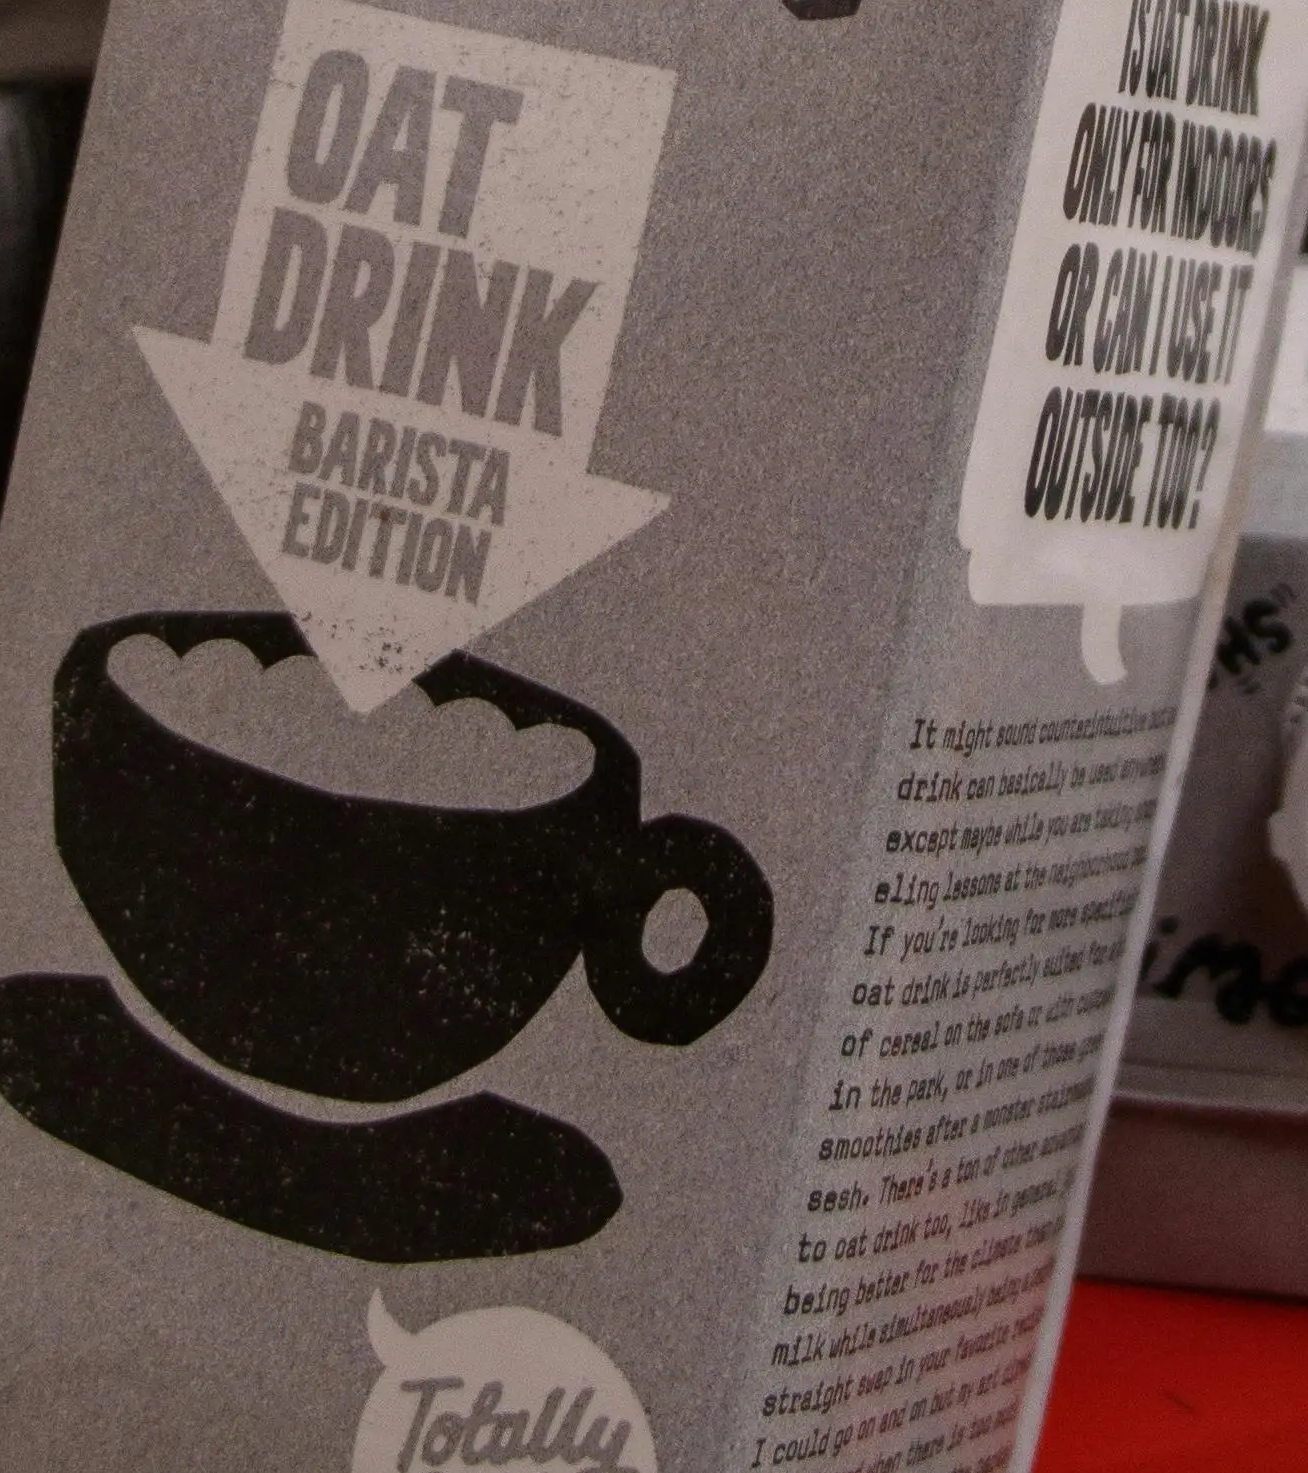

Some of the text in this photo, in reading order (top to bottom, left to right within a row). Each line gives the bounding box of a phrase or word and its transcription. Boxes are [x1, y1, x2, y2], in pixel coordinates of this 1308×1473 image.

[283, 49, 524, 240] OAT
[1061, 101, 1278, 258] ONLY FOR INDOORS
[243, 206, 601, 438] DRINK
[1045, 240, 1255, 387] OR CAN I USE IT
[288, 401, 512, 527] BARISTA
[1024, 386, 1221, 531] OUTSIDE TOO?
[280, 482, 492, 606] EDITION
[908, 716, 937, 751] It
[941, 719, 993, 759] might
[995, 717, 1038, 748] sound
[896, 770, 963, 803] drink
[965, 774, 995, 801] can
[997, 760, 1067, 797] basically
[885, 821, 958, 858] except
[959, 819, 1002, 857] maybe
[1004, 811, 1044, 845] while
[1044, 815, 1069, 845] you
[942, 870, 1001, 902] lessons
[1003, 863, 1021, 893] at
[1023, 862, 1047, 891] the
[862, 923, 895, 958] If
[899, 915, 958, 963] you're
[961, 913, 1020, 948] looking
[1023, 907, 1046, 935] for
[850, 976, 895, 1008] oat
[900, 972, 950, 1007] drink
[950, 968, 970, 1000] is
[971, 953, 1040, 999] perfectly
[839, 1027, 873, 1059] of
[879, 1020, 940, 1058] cereal
[943, 1021, 962, 1047] on
[966, 1014, 991, 1043] the
[993, 1004, 1024, 1037] sofa
[1026, 1005, 1042, 1028] or
[827, 1078, 861, 1113] in
[870, 1076, 902, 1109] the
[905, 1069, 948, 1107] park,
[954, 1068, 973, 1092] or
[974, 1057, 994, 1090] in
[995, 1056, 1020, 1081] one
[1022, 1043, 1040, 1074] of
[817, 1125, 921, 1163] smoothies
[925, 1114, 968, 1147] after
[969, 1112, 980, 1135] a
[806, 1180, 869, 1214] sesh.
[879, 1157, 938, 1204] There's
[940, 1166, 952, 1189] a
[955, 1156, 980, 1185] ton
[982, 1144, 1001, 1177] of
[797, 1231, 827, 1264] to
[833, 1227, 868, 1261] oat
[872, 1218, 919, 1255] drink
[922, 1212, 952, 1241] too,
[781, 1283, 850, 1321] being
[854, 1270, 910, 1306] better
[913, 1258, 939, 1288] for
[942, 1250, 968, 1279] the
[770, 1332, 825, 1369] milk
[828, 1322, 876, 1359] while
[762, 1375, 853, 1417] straight
[856, 1365, 893, 1397] swap
[893, 1355, 915, 1386] in
[915, 1347, 951, 1383] your
[748, 1436, 767, 1470] I
[771, 1426, 831, 1466] could
[831, 1424, 853, 1459] go
[856, 1416, 876, 1441] on
[878, 1401, 908, 1434] and
[908, 1397, 927, 1422] on
[928, 1384, 955, 1416] but
